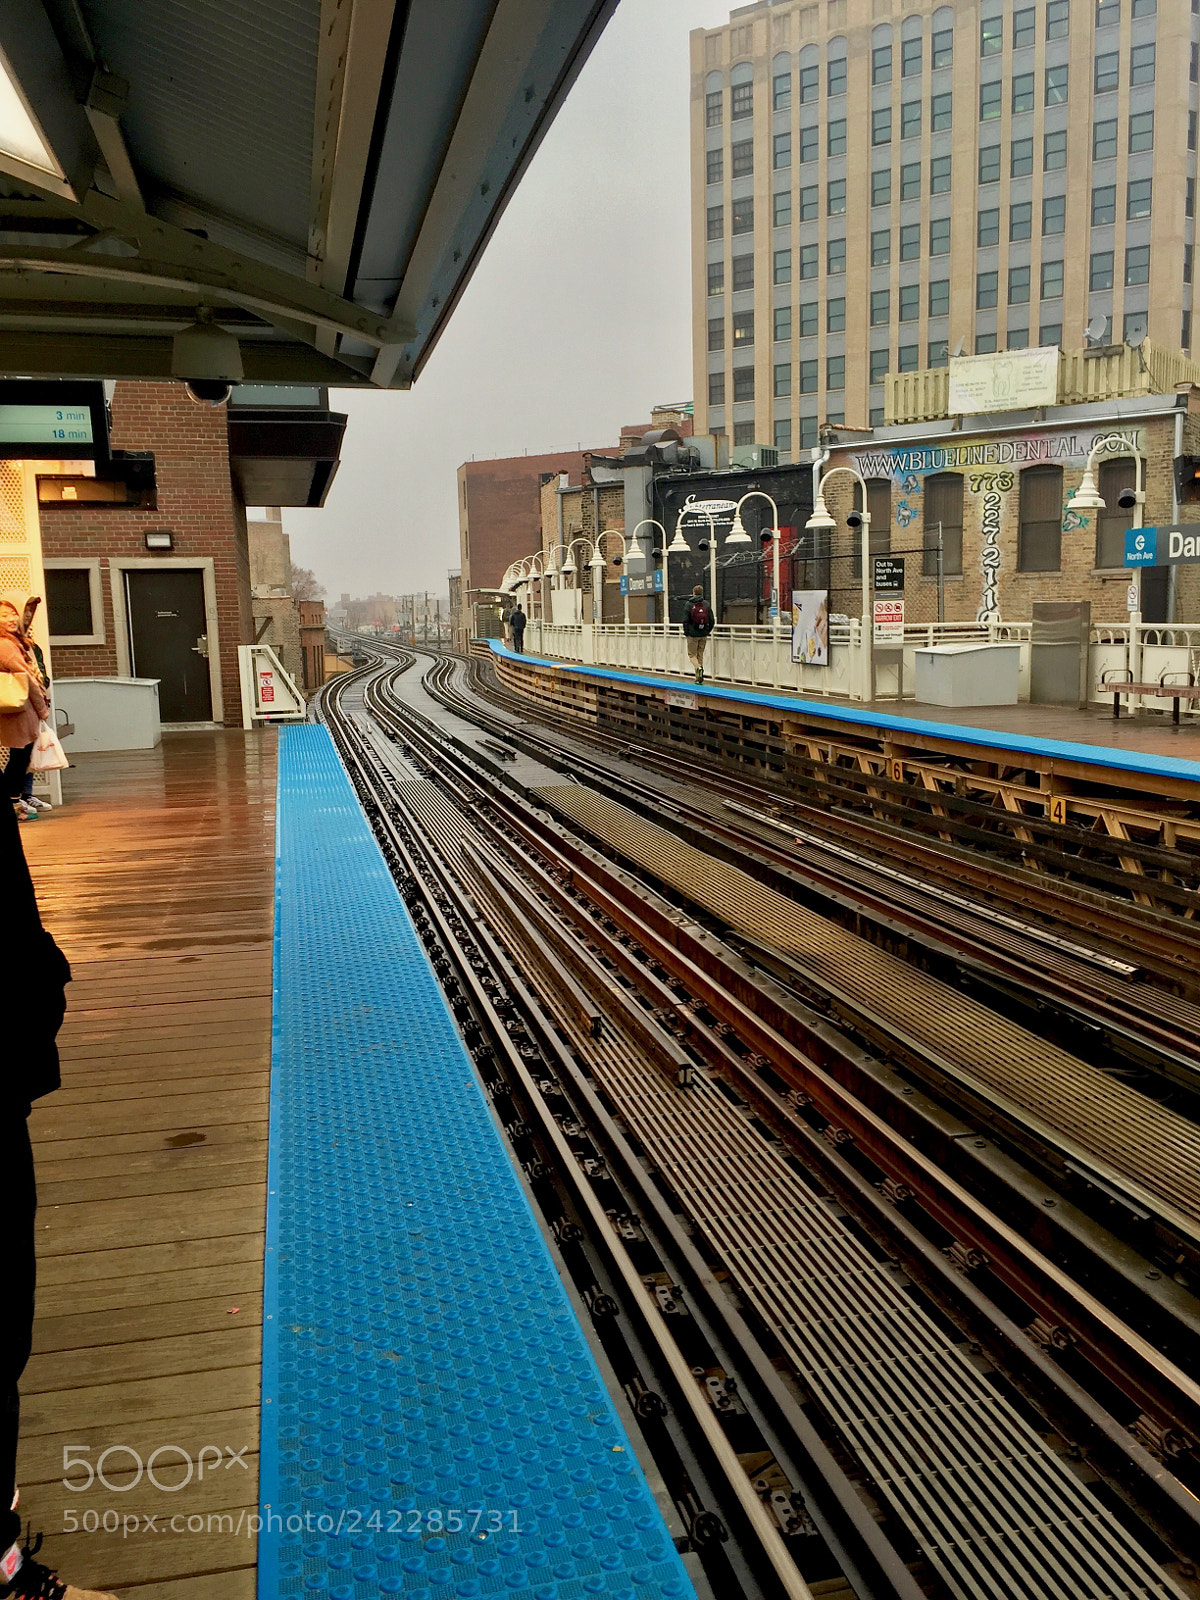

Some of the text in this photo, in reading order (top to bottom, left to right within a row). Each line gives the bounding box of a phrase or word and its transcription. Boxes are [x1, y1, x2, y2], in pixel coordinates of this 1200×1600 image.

[56, 411, 85, 420] 3 min
[52, 429, 87, 439] 18 min
[969, 471, 1015, 493] 773
[1126, 551, 1154, 561] North Ave
[893, 762, 901, 780] 6
[1053, 800, 1063, 823] 4
